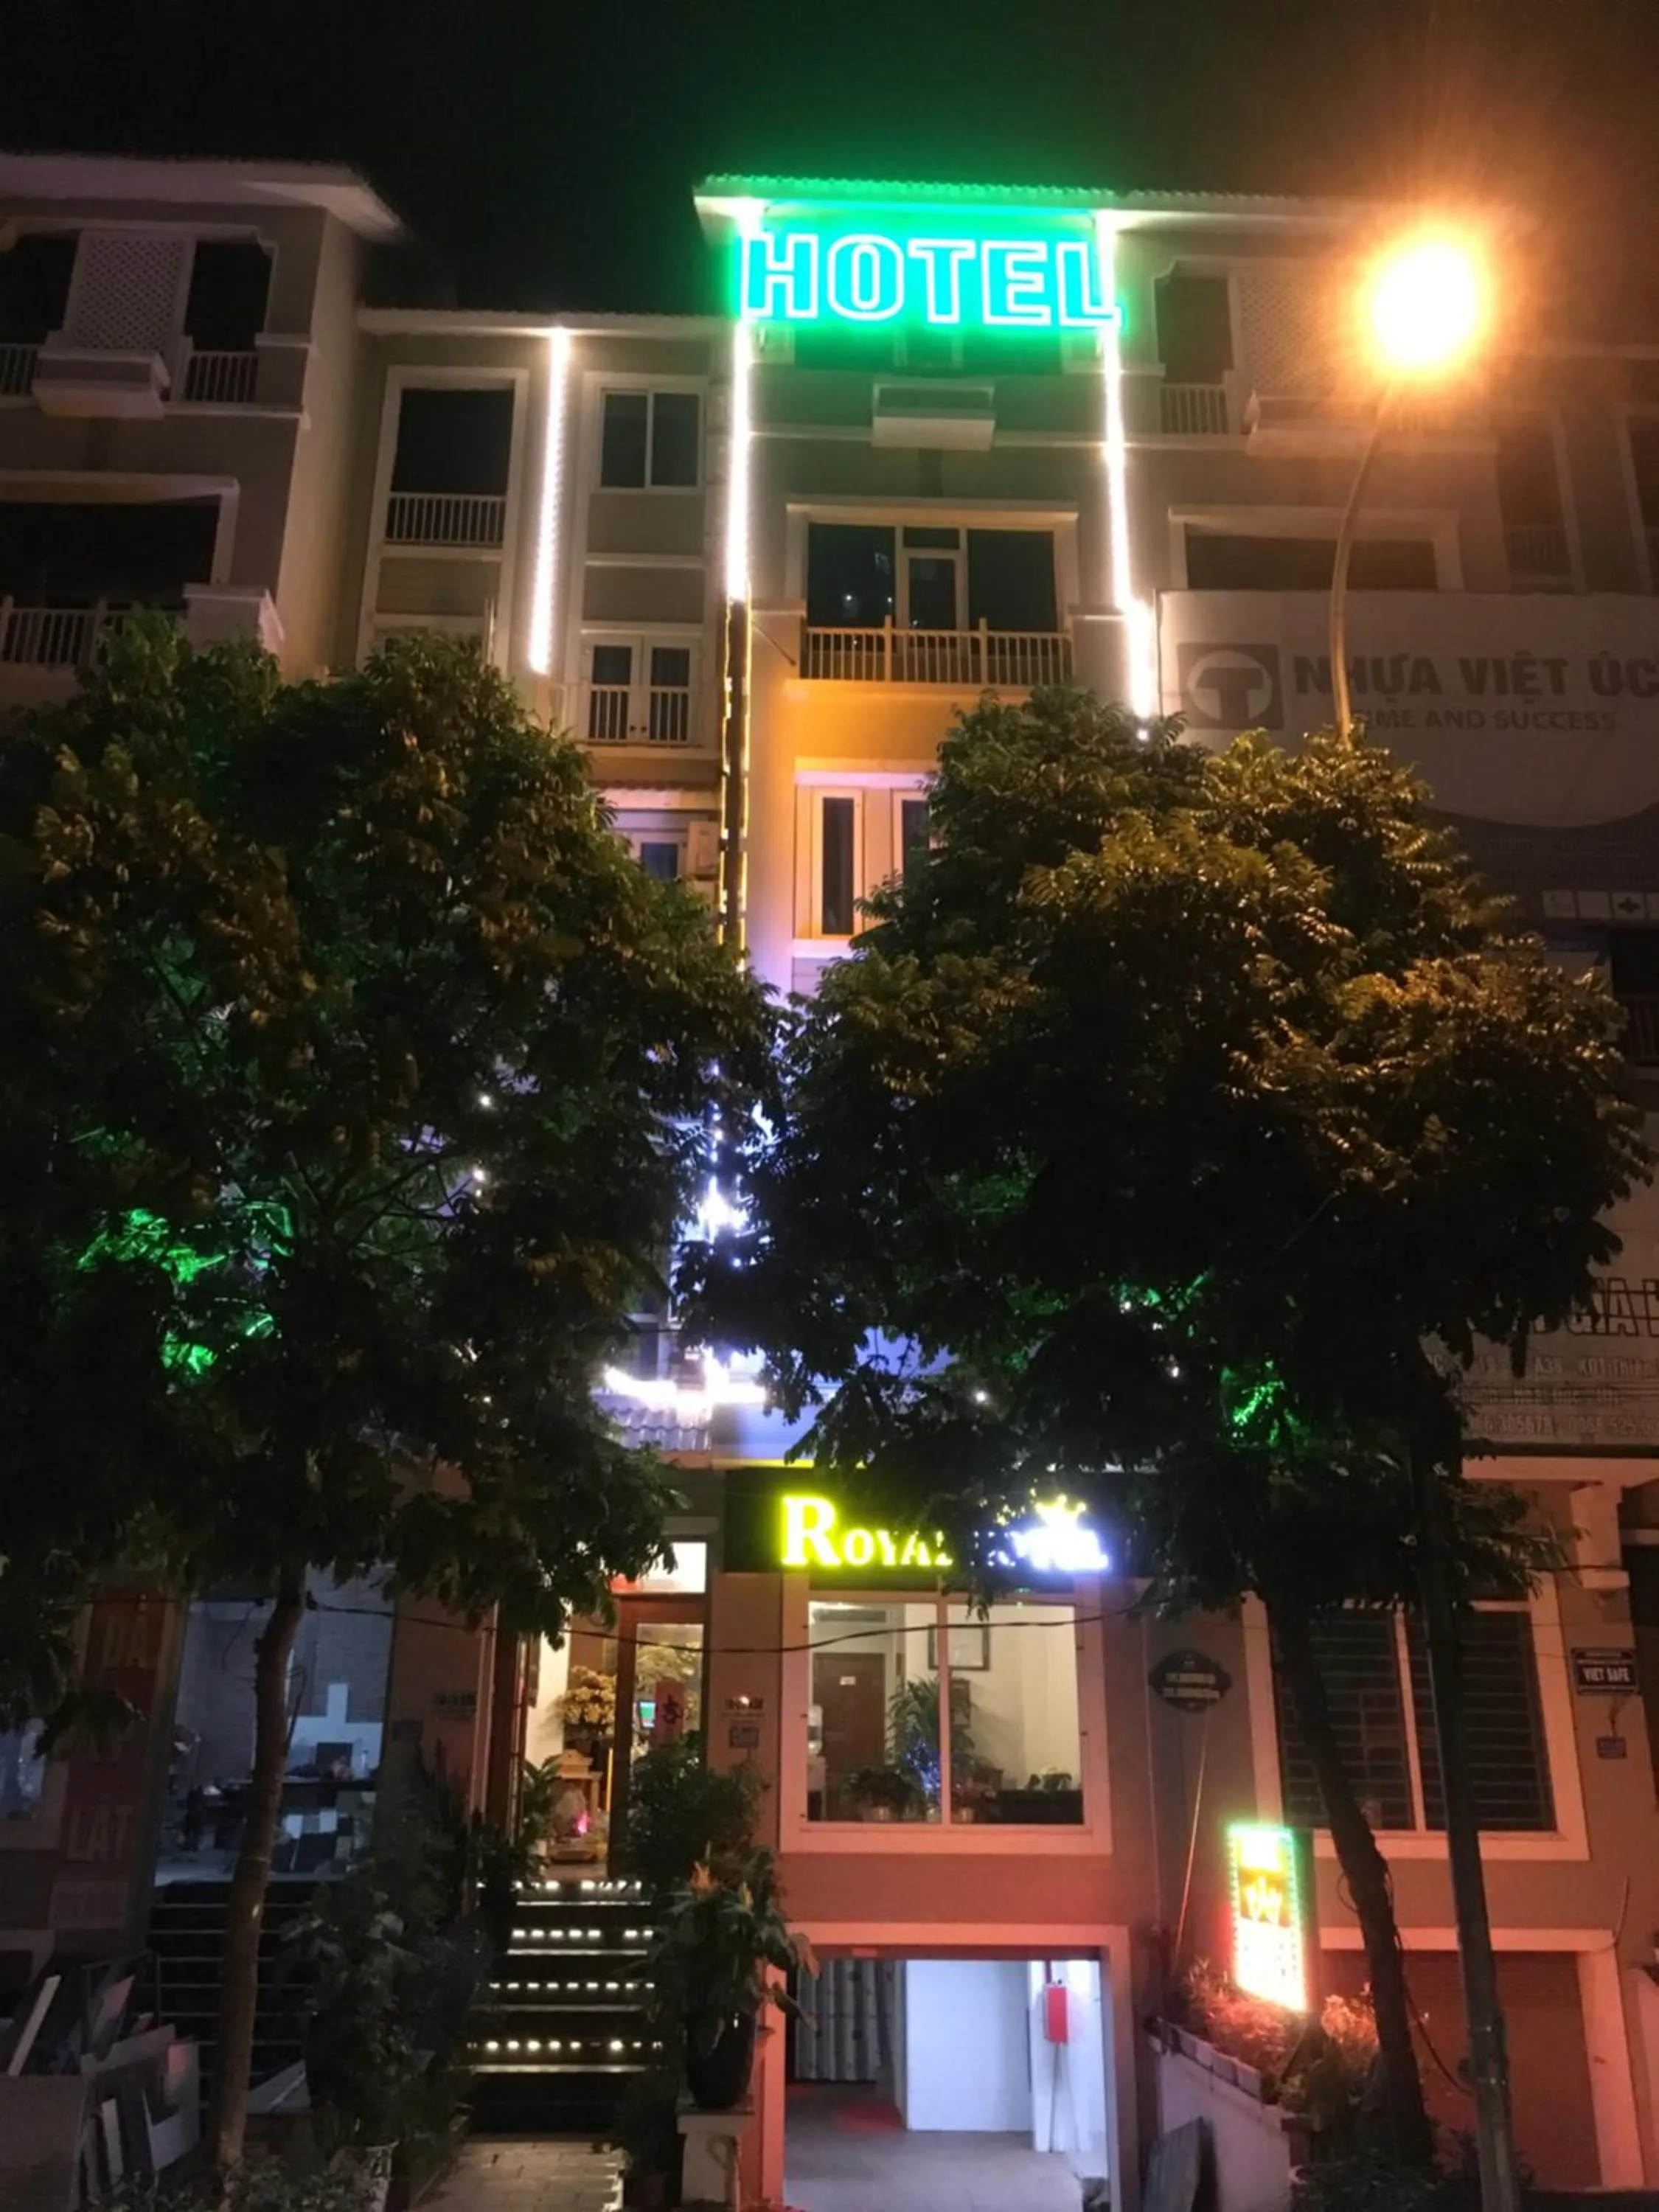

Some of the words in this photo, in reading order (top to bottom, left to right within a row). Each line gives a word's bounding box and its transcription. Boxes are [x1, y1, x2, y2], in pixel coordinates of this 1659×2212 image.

[740, 232, 1121, 327] HOTEL
[1458, 650, 1568, 703] VIỆT
[1588, 650, 1659, 698] ÚC
[1425, 710, 1484, 730] AND
[1493, 709, 1618, 731] SUCCESS
